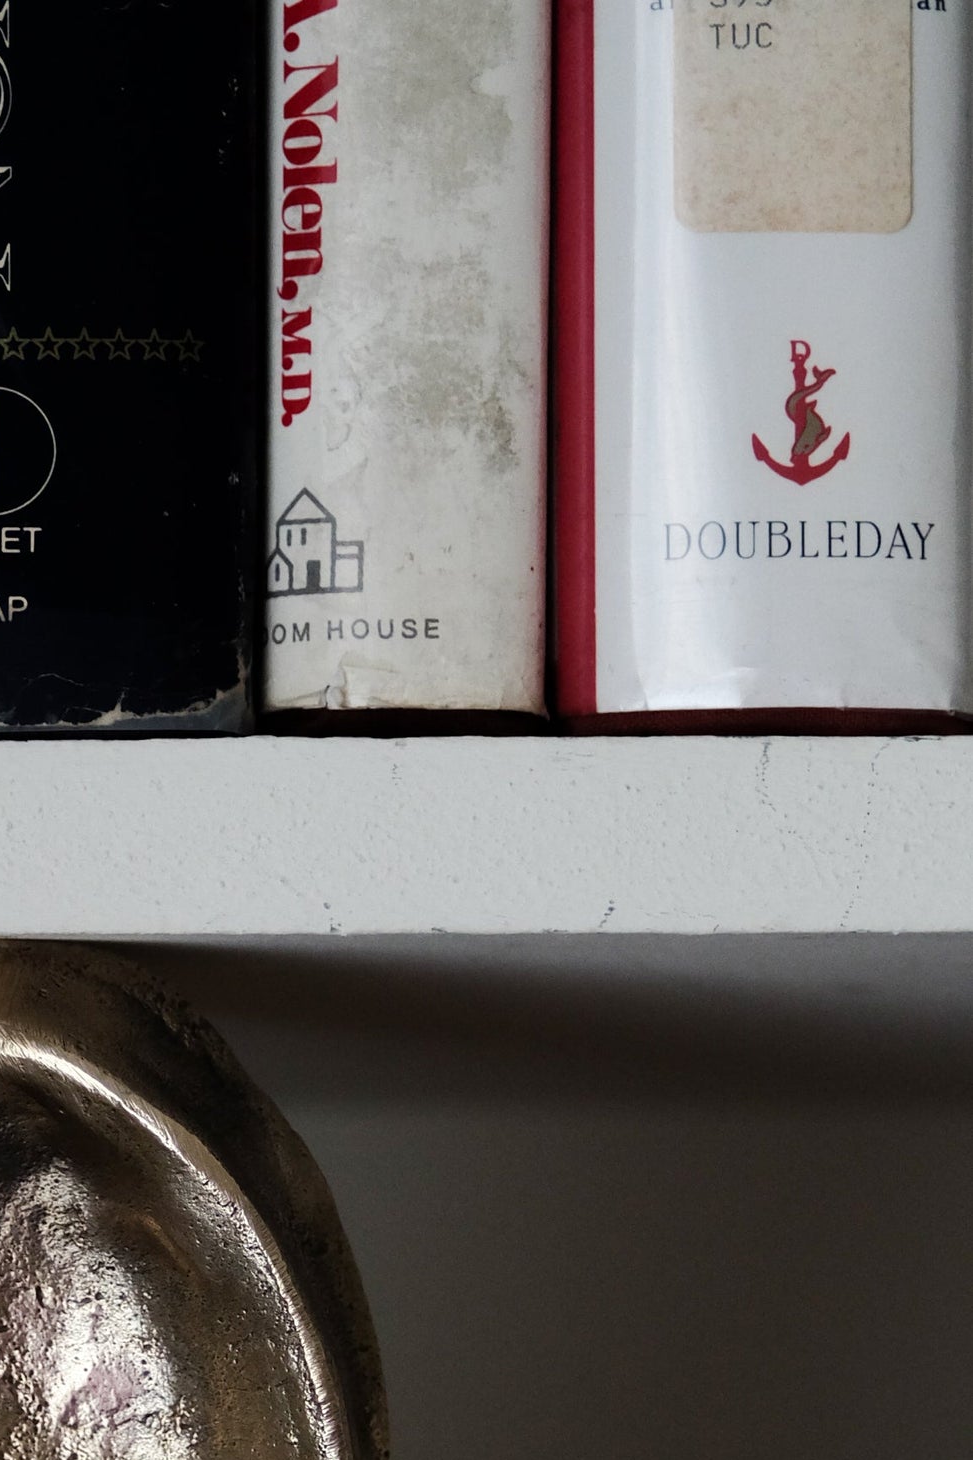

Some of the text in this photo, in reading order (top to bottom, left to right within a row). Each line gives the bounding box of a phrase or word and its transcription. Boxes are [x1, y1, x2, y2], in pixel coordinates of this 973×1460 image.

[709, 22, 774, 50] TUC
[278, 57, 339, 300] Nolen,
[280, 306, 313, 428] M.D.
[664, 520, 936, 563] DOUBLEDAY
[327, 617, 440, 641] HOUSE
